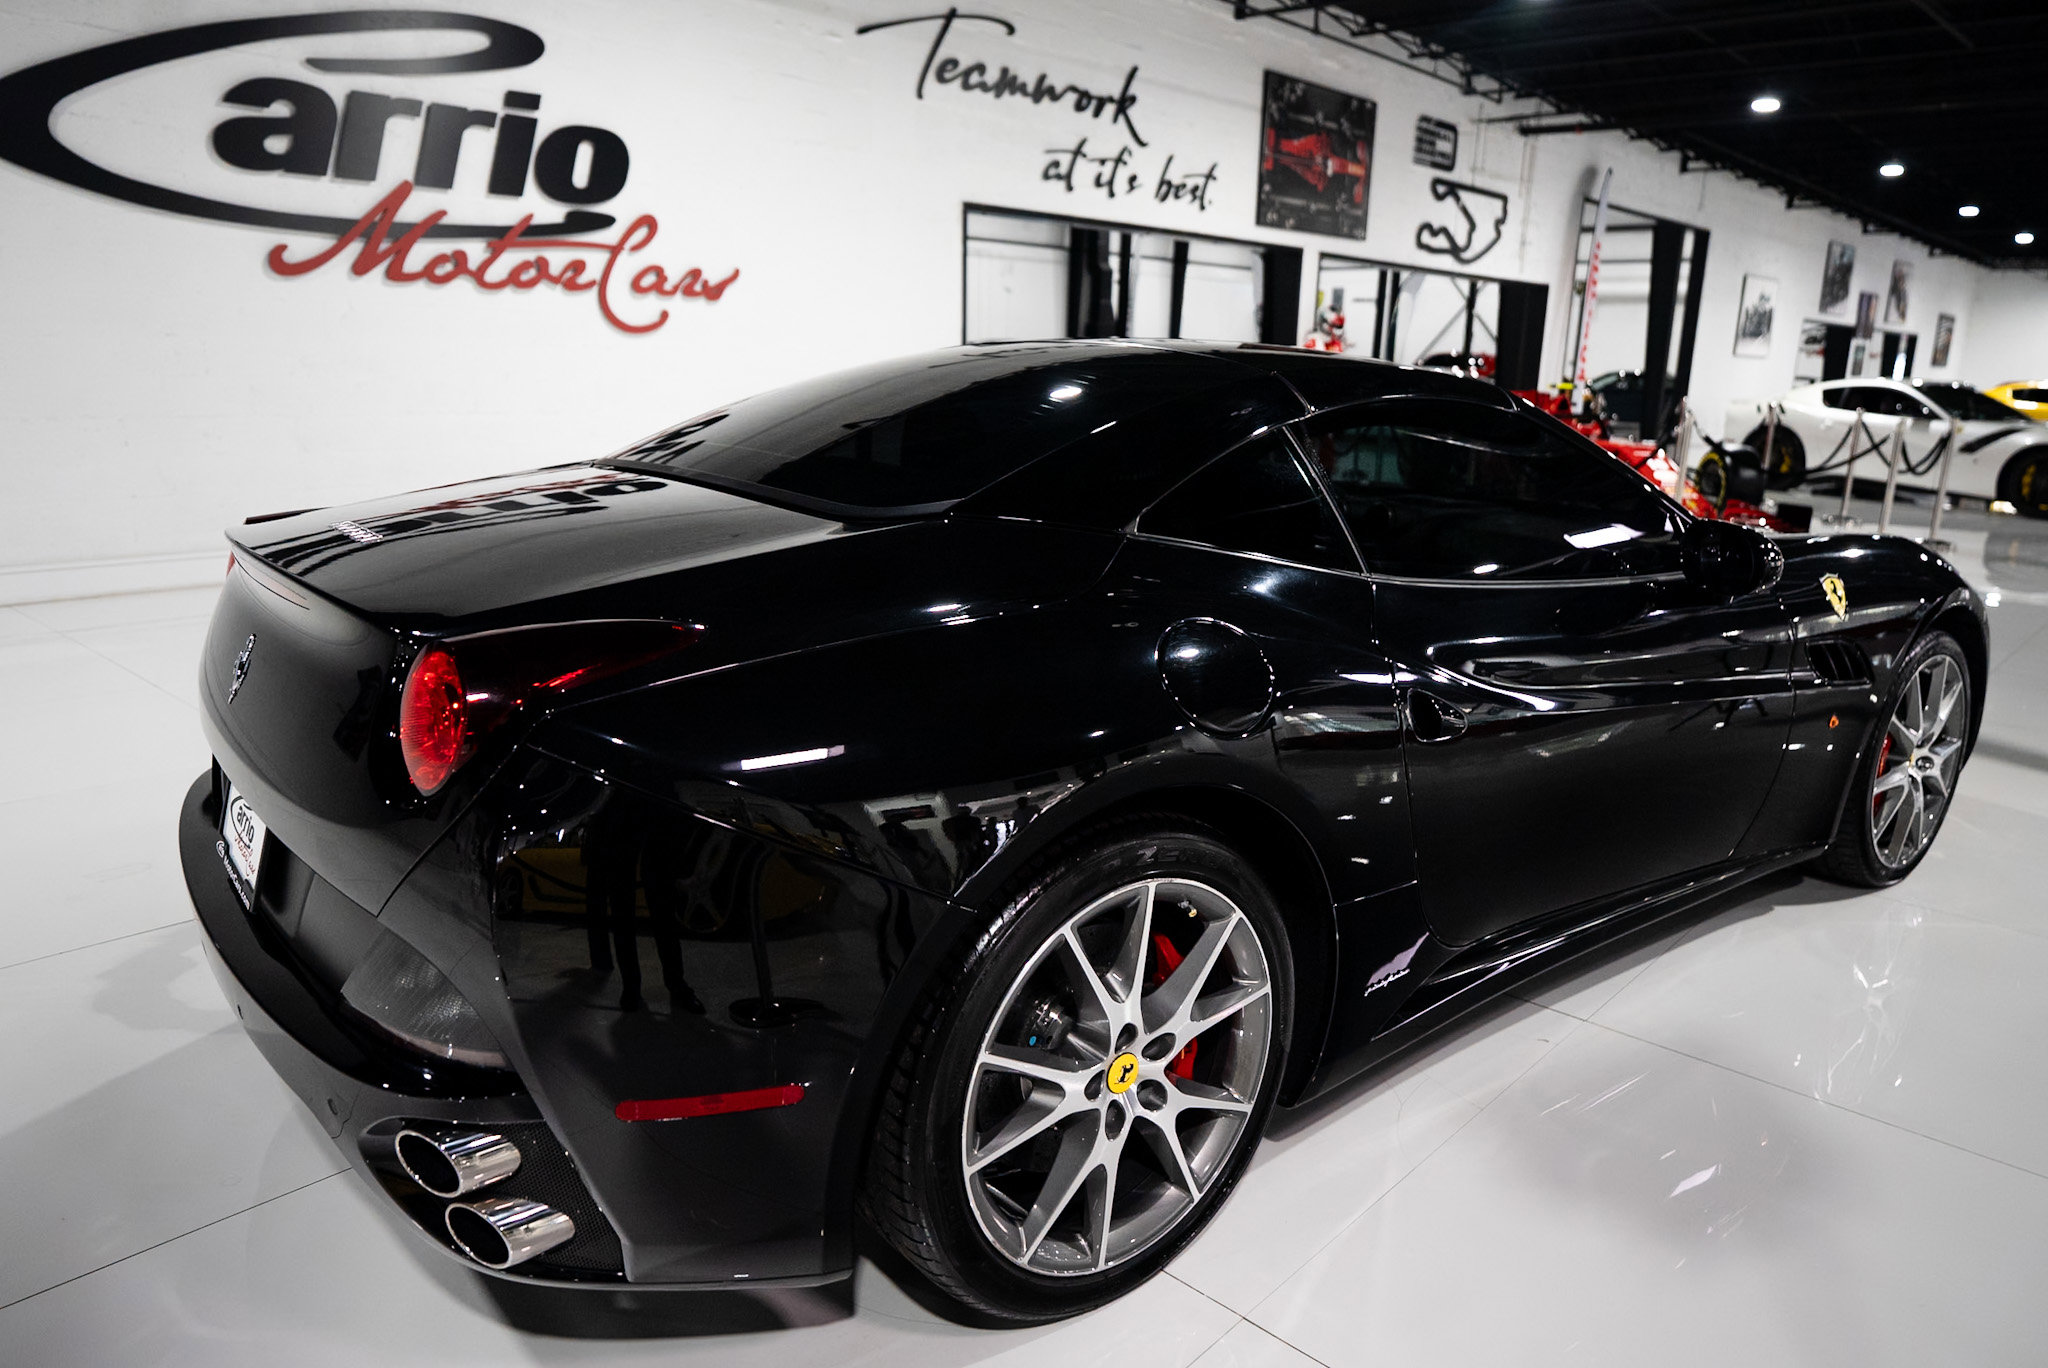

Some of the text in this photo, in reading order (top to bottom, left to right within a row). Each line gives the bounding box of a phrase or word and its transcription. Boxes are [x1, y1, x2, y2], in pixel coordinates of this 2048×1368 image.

[0, 9, 631, 239] Carrio
[856, 6, 1147, 147] Teamwork
[1042, 137, 1087, 192] at
